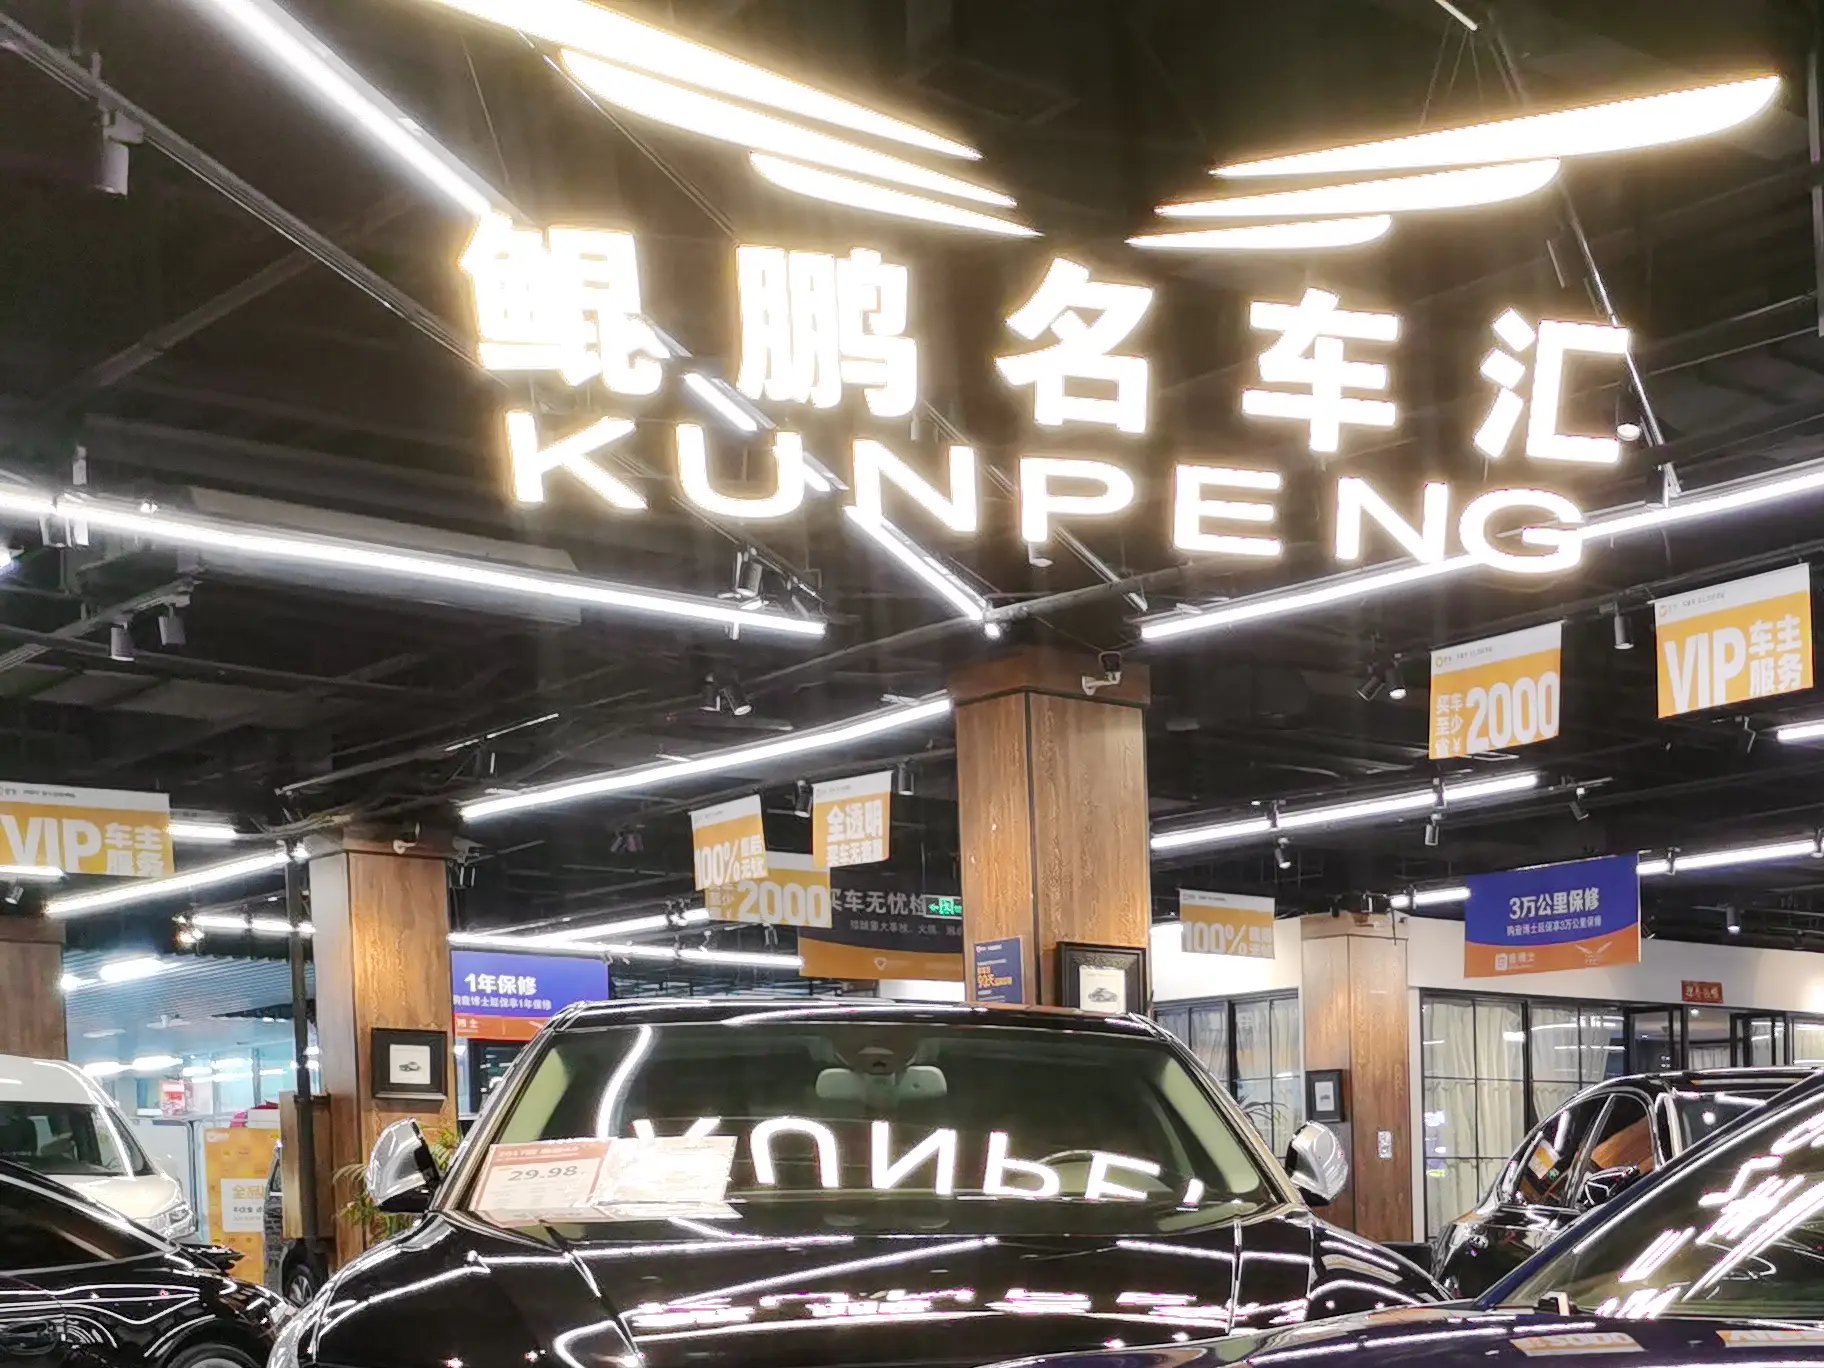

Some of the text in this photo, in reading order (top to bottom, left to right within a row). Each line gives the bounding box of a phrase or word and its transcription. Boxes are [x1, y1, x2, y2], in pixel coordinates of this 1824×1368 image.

[461, 212, 1633, 466] 鲲鹏名车汇
[505, 408, 1592, 574] KUNPENG
[1749, 613, 1803, 656] 车主
[1664, 626, 1747, 714] VIP
[1749, 653, 1803, 699] 服务
[1436, 691, 1464, 715] 买车
[1465, 671, 1560, 754] 2000
[1436, 714, 1464, 737] 至少
[105, 822, 163, 850] 车主
[826, 799, 883, 842] 全透明
[0, 814, 103, 874] VIP
[106, 849, 164, 878] 服务
[694, 838, 741, 890] 100%
[737, 880, 830, 927] 2000
[1508, 887, 1600, 919] 3万公里保修
[1181, 921, 1249, 955] 100%
[464, 973, 537, 996] 1年保修
[508, 1165, 578, 1182] 29.98
